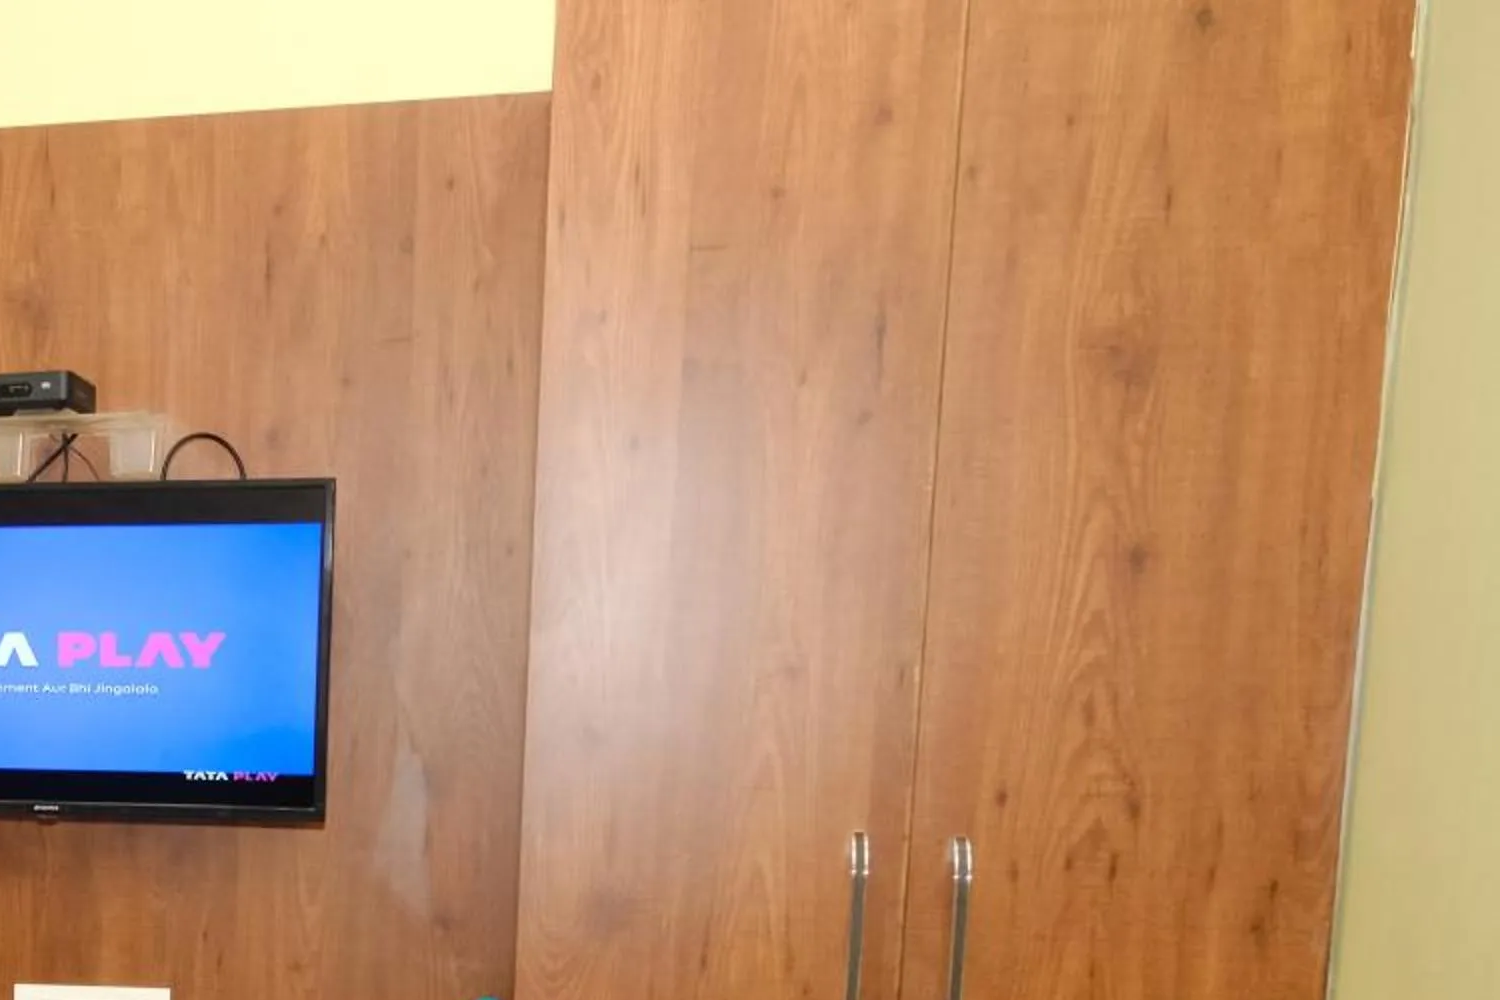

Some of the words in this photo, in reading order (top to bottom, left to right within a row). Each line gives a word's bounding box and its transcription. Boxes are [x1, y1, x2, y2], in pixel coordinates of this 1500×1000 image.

[56, 632, 227, 669] PLAY
[69, 682, 91, 694] Bhi
[183, 770, 228, 781] TATA
[233, 770, 279, 783] PLAY
